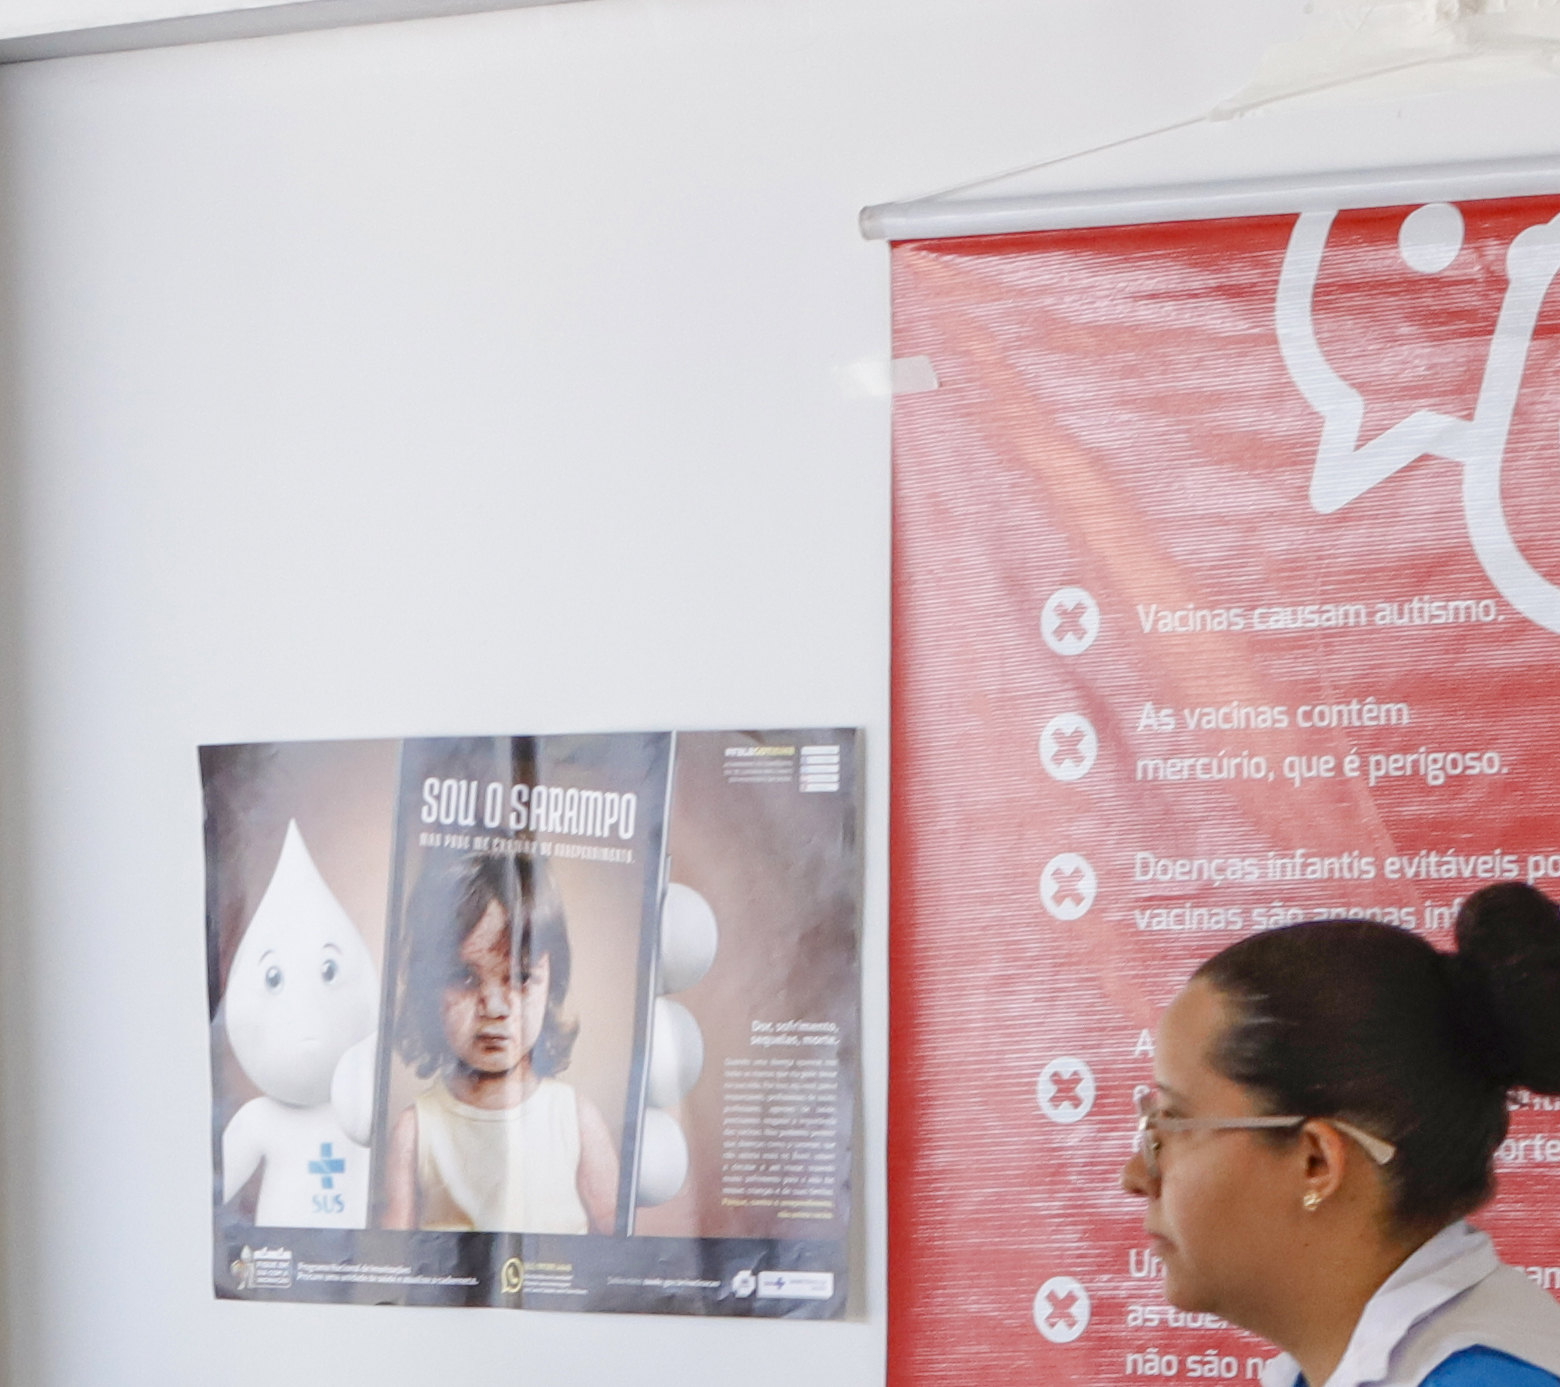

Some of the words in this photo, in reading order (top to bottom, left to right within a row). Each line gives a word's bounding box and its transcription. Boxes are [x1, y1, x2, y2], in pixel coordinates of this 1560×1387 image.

[1137, 602, 1246, 634] Vacinas
[1252, 601, 1368, 630] causam
[1374, 595, 1506, 626] autismo.
[1137, 701, 1177, 732] As
[1182, 700, 1290, 731] vacinas
[1296, 696, 1412, 728] contêm
[1136, 750, 1276, 782] mercúrio,
[1283, 754, 1336, 788] que
[1343, 747, 1363, 776] é
[1368, 746, 1511, 787] perigoso.
[420, 777, 479, 827] SOU
[484, 782, 504, 828] O
[508, 783, 638, 840] SARAMPO
[1133, 852, 1261, 887] Doenças
[1267, 849, 1377, 880] infantis
[1383, 846, 1520, 880] evitáveis
[1133, 902, 1244, 931] vacinas
[312, 1194, 345, 1214] SUS
[1125, 1348, 1178, 1376] não
[1186, 1349, 1238, 1378] são
